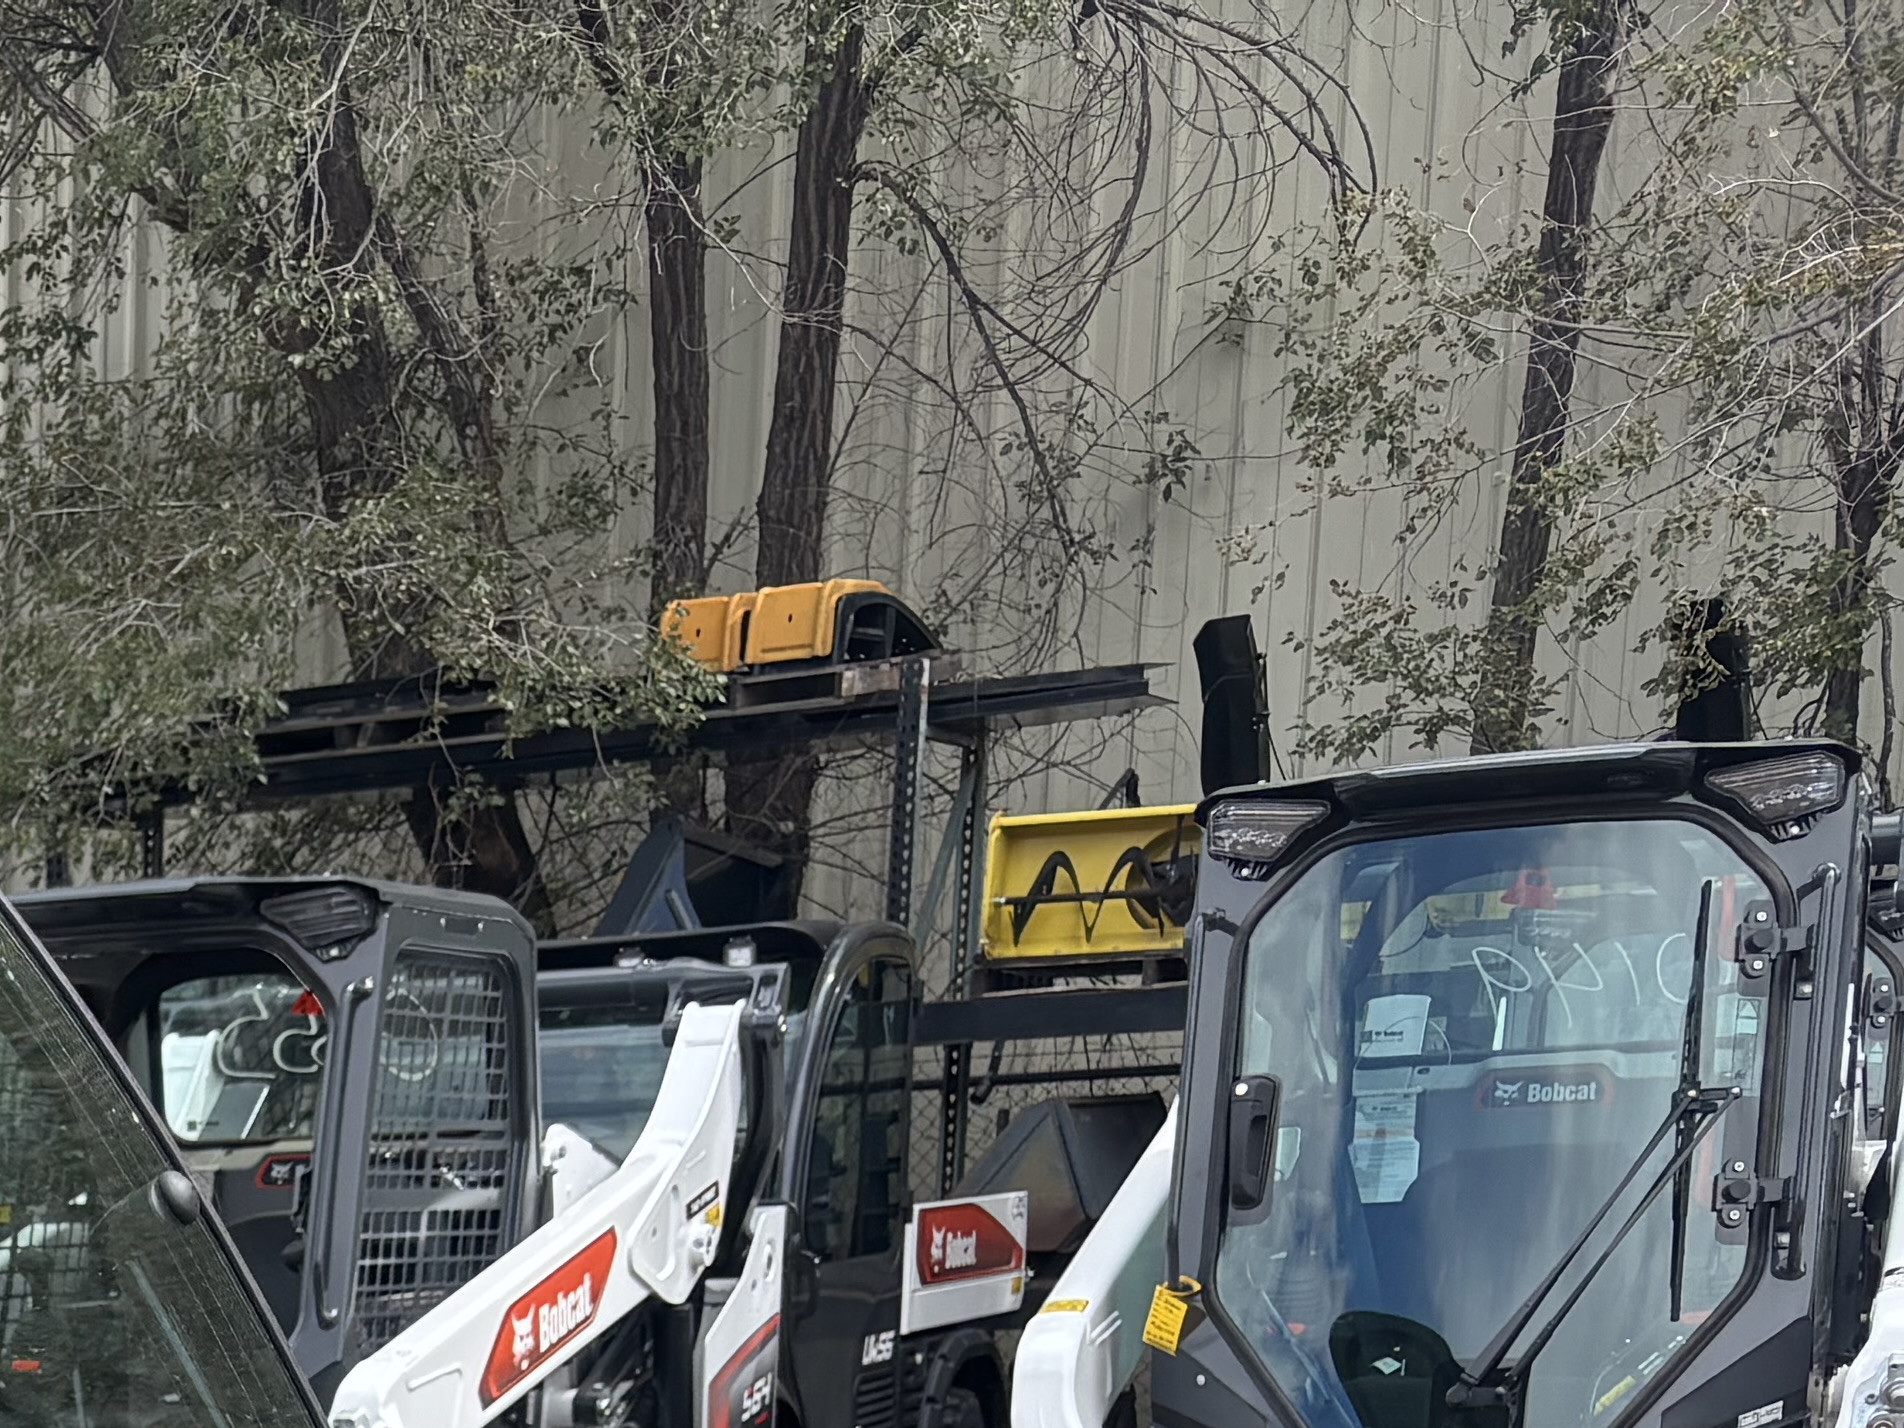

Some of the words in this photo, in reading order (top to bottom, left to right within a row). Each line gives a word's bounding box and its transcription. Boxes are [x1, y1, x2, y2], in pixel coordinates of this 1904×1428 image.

[1526, 1082, 1597, 1104] Bobcat
[945, 1229, 977, 1270] Bobcat
[539, 1271, 594, 1354] Bobcat
[741, 1371, 773, 1423] S64
